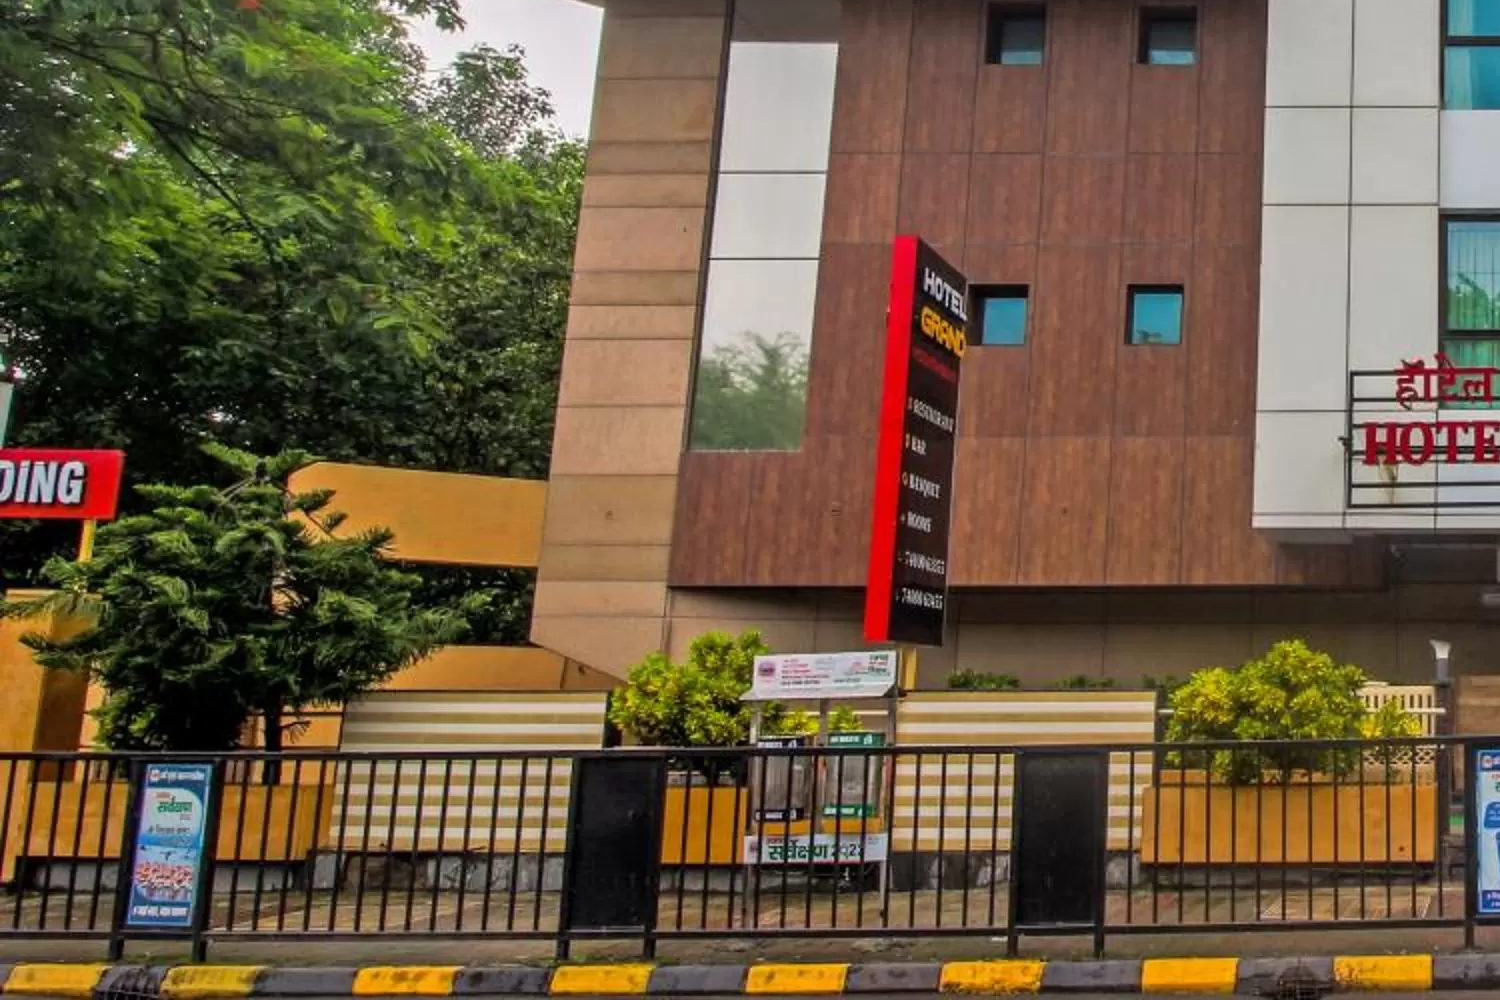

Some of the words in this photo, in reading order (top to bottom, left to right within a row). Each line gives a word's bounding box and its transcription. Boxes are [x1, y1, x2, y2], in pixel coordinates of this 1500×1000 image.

[923, 267, 968, 321] HOTEL
[921, 305, 967, 357] GRAND
[1394, 351, 1498, 410] हॉटेल
